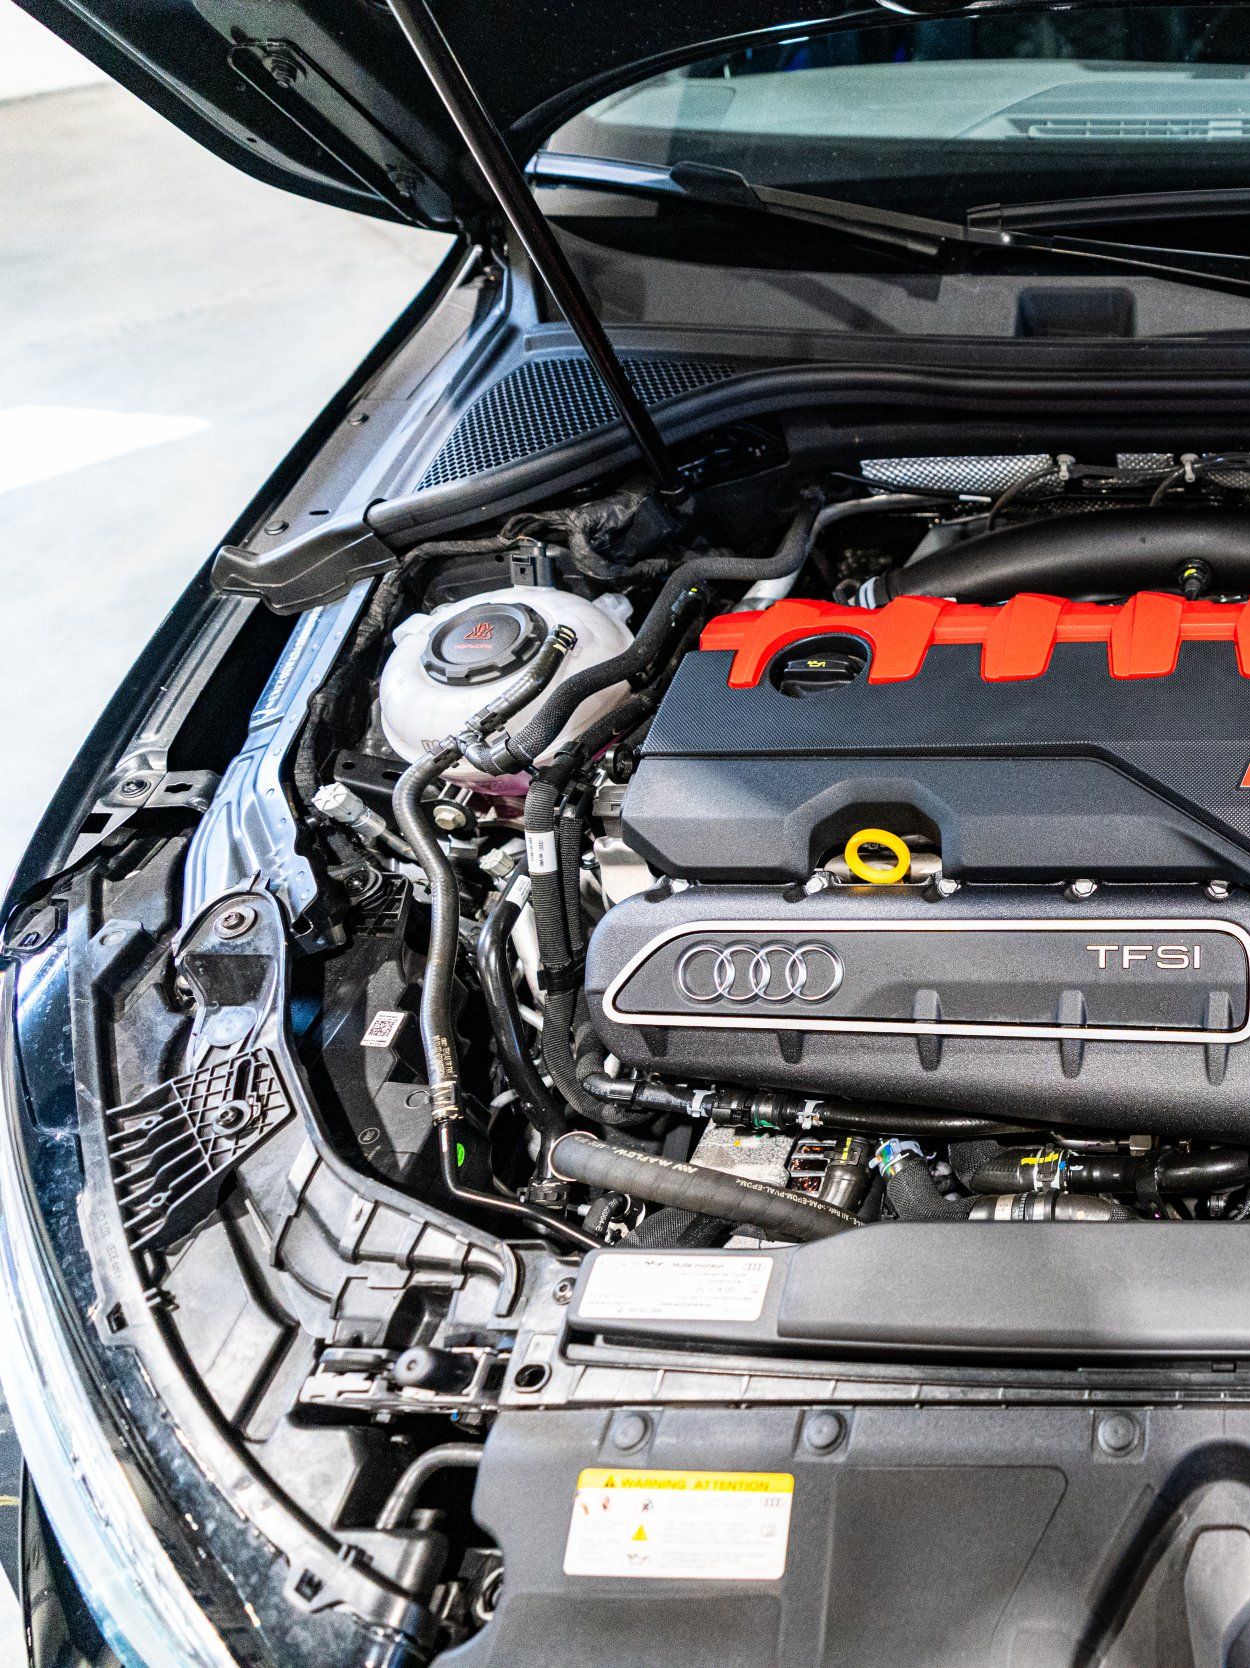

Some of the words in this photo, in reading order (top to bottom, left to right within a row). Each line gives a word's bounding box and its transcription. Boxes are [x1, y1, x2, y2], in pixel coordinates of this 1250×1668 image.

[1087, 945, 1200, 969] TFSI
[621, 1478, 687, 1490] WARNING
[694, 1480, 770, 1492] ATTENTION
